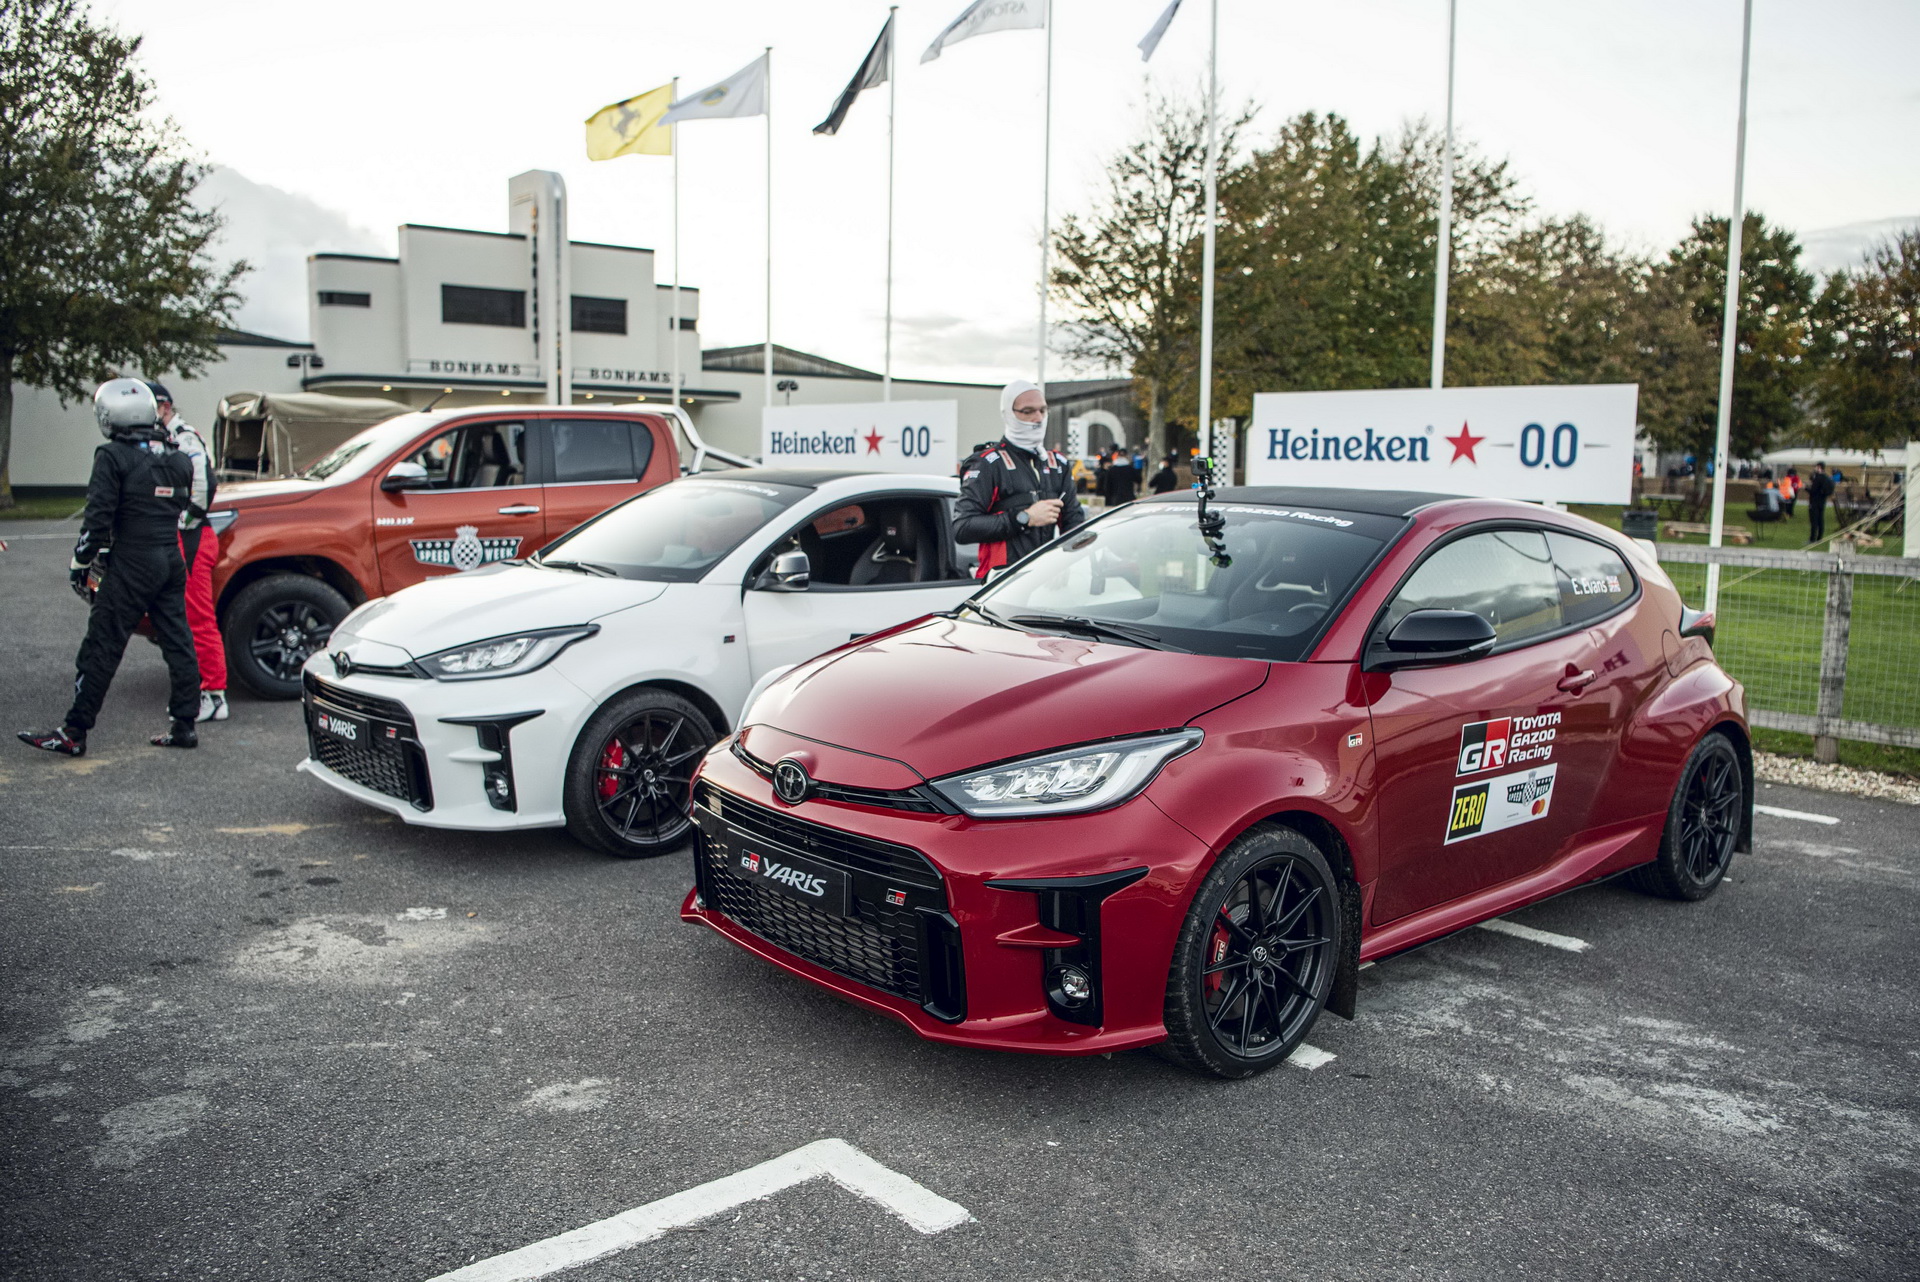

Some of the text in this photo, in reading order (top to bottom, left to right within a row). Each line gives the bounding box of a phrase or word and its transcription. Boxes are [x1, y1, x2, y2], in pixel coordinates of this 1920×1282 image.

[430, 361, 521, 377] BONHAMS
[590, 368, 671, 384] BONHAMS
[771, 426, 931, 458] Heineken 0.0
[1267, 423, 1579, 469] Heineken 0.0
[1289, 511, 1354, 528] Racing
[418, 547, 515, 564] SPEED WEEK
[1581, 577, 1608, 595] Evans
[1512, 711, 1562, 732] TOYOTA
[1510, 728, 1556, 748] GAZOO
[1459, 738, 1507, 773] GR
[1507, 744, 1553, 764] Racing
[1451, 792, 1487, 831] ZERO
